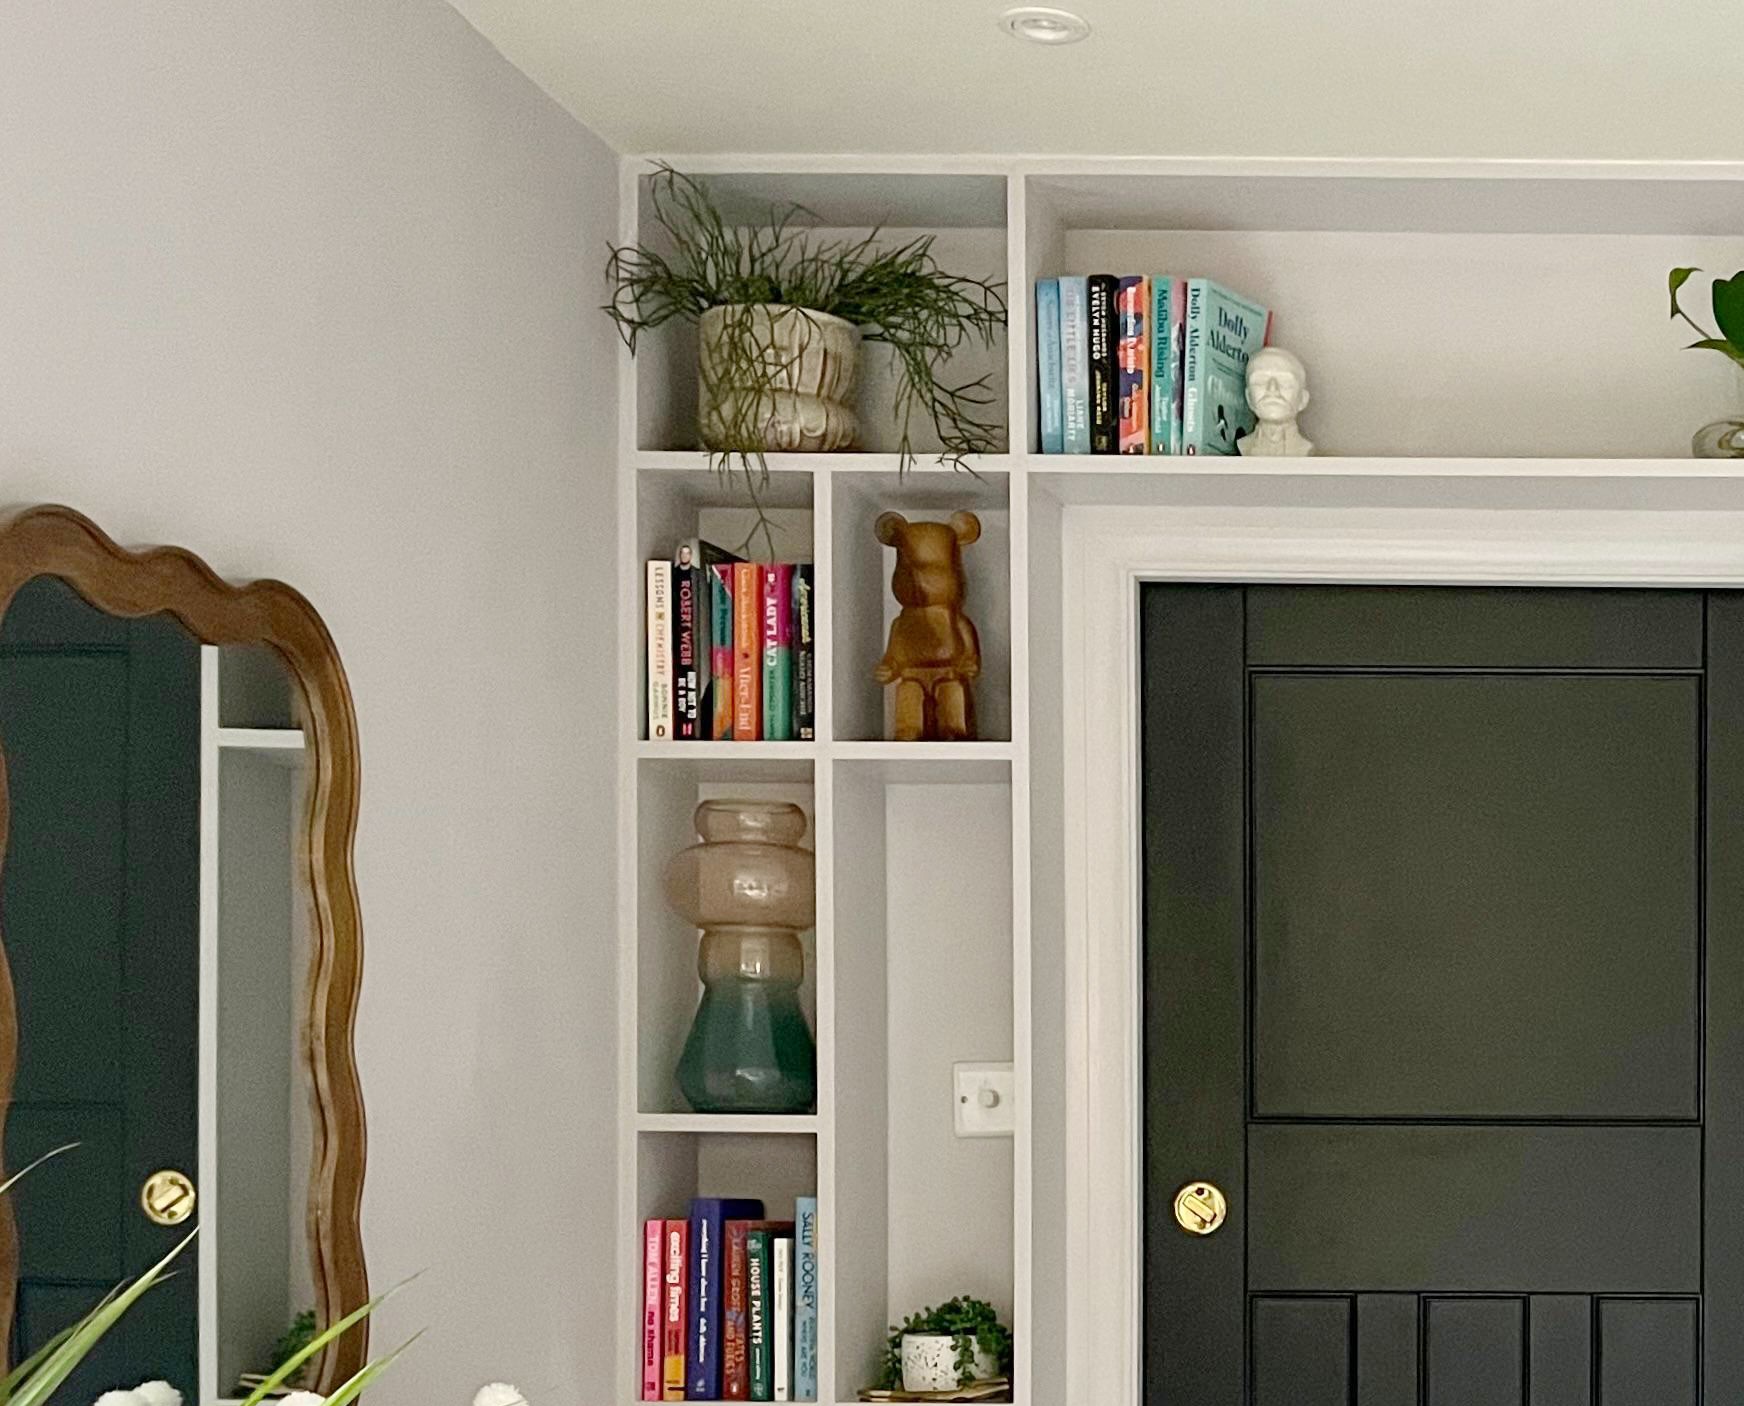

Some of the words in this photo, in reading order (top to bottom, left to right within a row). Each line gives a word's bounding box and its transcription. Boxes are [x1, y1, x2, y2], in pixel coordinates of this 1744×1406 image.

[1091, 286, 1101, 327] EVELYN
[1156, 288, 1169, 334] Malibu
[1187, 287, 1202, 322] Dolly
[1092, 329, 1101, 361] HUGO
[1217, 306, 1249, 345] Dolly
[1154, 336, 1169, 379] Rising
[1188, 327, 1201, 383] Alderton
[1206, 329, 1250, 365] Alderto
[654, 567, 665, 609] LESSONS
[680, 580, 692, 628] ROBERT
[766, 596, 778, 636] LADY
[680, 631, 692, 666] WEBB
[766, 639, 778, 667] CAT
[801, 1211, 814, 1248] SALLY
[666, 1231, 683, 1284] exciting
[750, 1257, 761, 1297] HOUSE
[802, 1252, 815, 1309] ROONEY
[647, 1310, 656, 1326] no
[668, 1286, 683, 1323] times
[751, 1300, 763, 1345] PLANTS
[647, 1329, 656, 1367] shame
